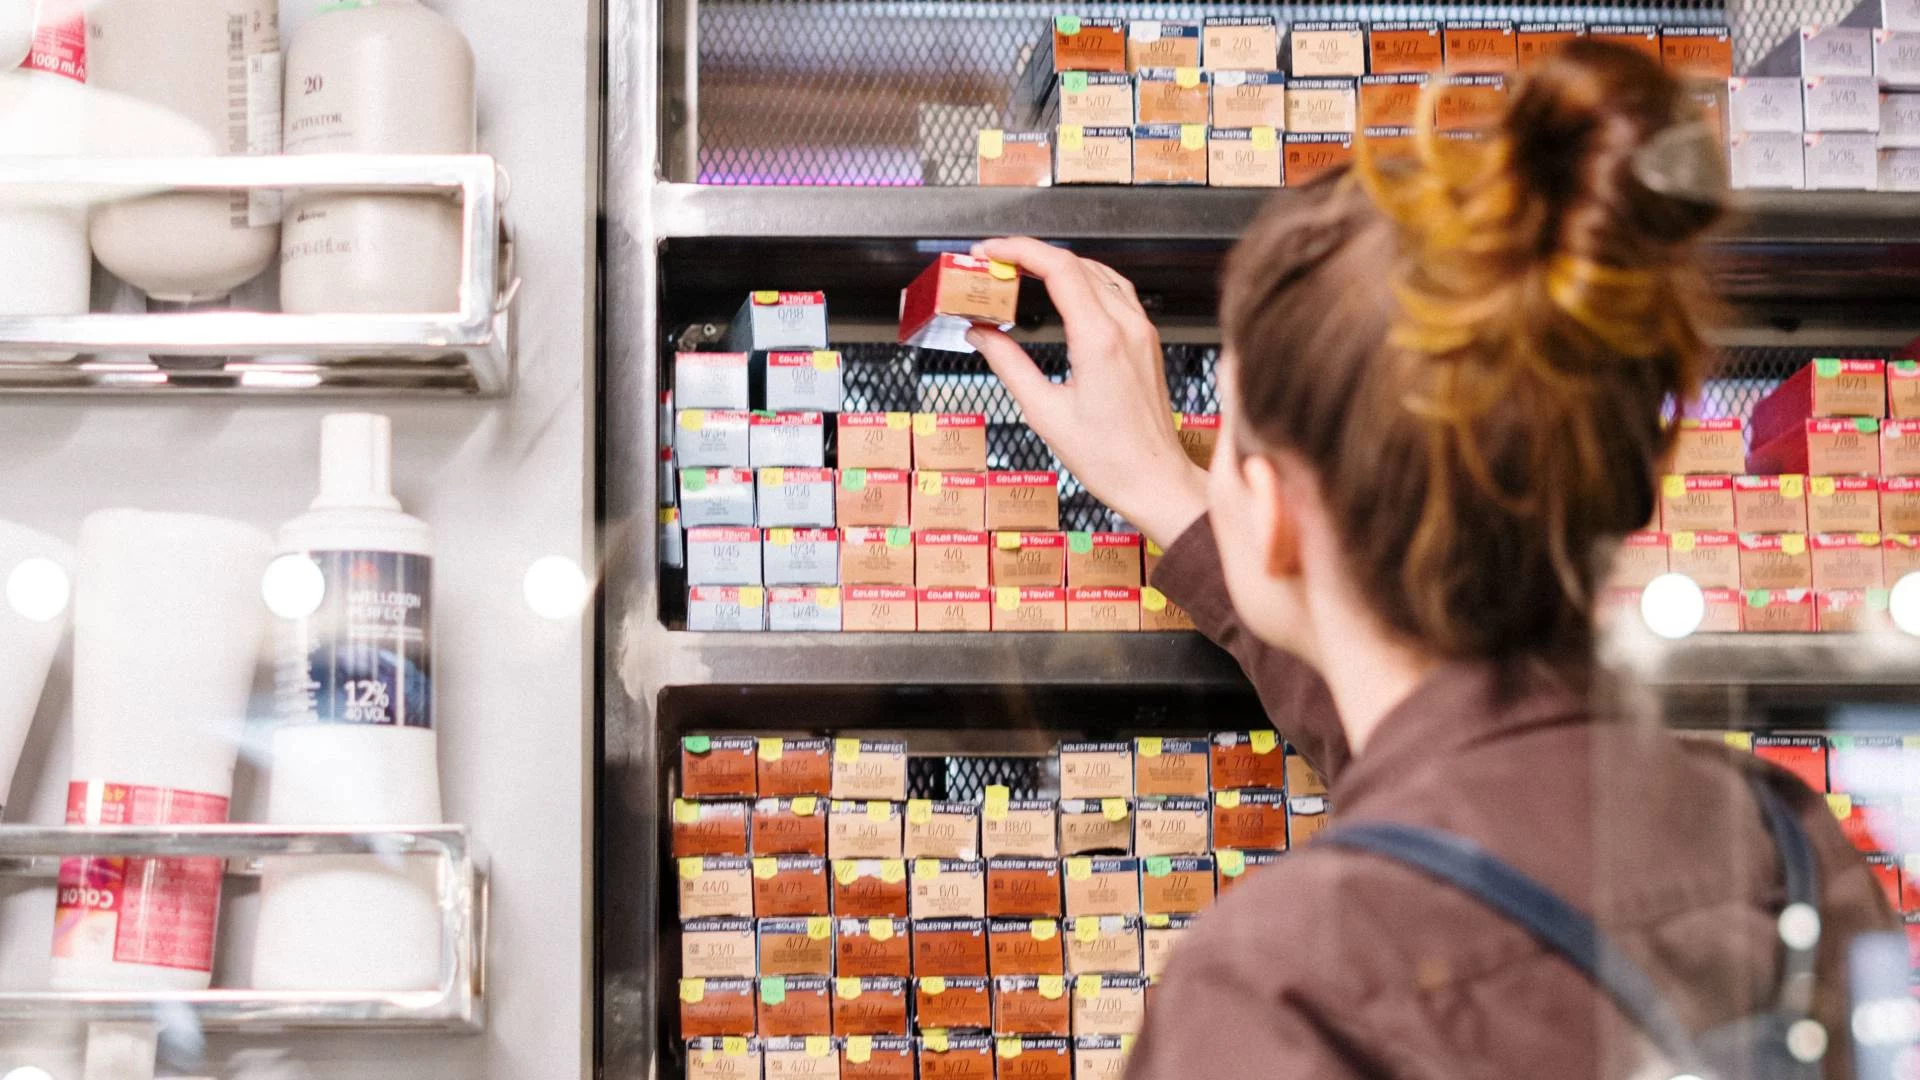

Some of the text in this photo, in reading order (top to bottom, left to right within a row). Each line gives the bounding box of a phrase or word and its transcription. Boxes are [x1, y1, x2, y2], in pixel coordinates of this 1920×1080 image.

[1094, 18, 1121, 26] PERFECT
[1243, 17, 1271, 25] PERFECT
[1447, 20, 1512, 29] KOLESTON PERFECT
[1331, 22, 1359, 30] PERFECT
[1373, 21, 1437, 30] KOLESTON PERFECT
[1520, 23, 1585, 32] KOLESTON PERFECT
[1628, 25, 1656, 33] PERFECT
[1700, 27, 1728, 35] PERFECT
[32, 52, 59, 69] 1000
[1100, 75, 1128, 83] PERFECT
[1363, 75, 1428, 84] KOLESTON PERFECT
[304, 75, 323, 94] 20
[1288, 80, 1351, 88] KOLESTON PERFECT
[1099, 128, 1127, 136] PERFECT
[1212, 130, 1247, 138] KOLESTON
[1018, 133, 1047, 141] PERFECT
[1286, 133, 1352, 143] KOLESTON PERFECT
[848, 416, 874, 424] COLOR
[951, 416, 976, 424] TOUCH
[1190, 416, 1216, 424] TOUCH
[875, 472, 898, 480] TOUCH
[997, 475, 1049, 483] COLOR TOUCH
[950, 477, 975, 485] TOUCH
[1106, 535, 1130, 543] TOUCH
[853, 590, 906, 598] COLOR TOUCH
[927, 591, 981, 599] COLOR TOUCH
[344, 679, 390, 708] 12%
[875, 743, 903, 751] PERFECT
[1063, 743, 1098, 751] KOLESTON
[1254, 794, 1282, 802] PERFECT
[947, 805, 975, 813] PERFECT
[1023, 802, 1050, 810] PERFECT
[719, 860, 747, 869] PERFECT
[794, 859, 822, 868] PERFECT
[951, 863, 980, 871] PERFECT
[990, 860, 1056, 869] KOLESTON PERFECT
[685, 921, 750, 930] KOLESTON PERFECT
[916, 921, 982, 931] KOLESTON PERFECT
[992, 923, 1027, 931] KOLESTON
[797, 981, 826, 989] PERFECT
[873, 981, 901, 989] PERFECT
[956, 980, 984, 988] PERFECT
[1112, 978, 1140, 986] PERFECT
[881, 1040, 909, 1048] PERFECT
[960, 1040, 989, 1048] PERFECT
[1038, 1039, 1066, 1048] PERFECT
